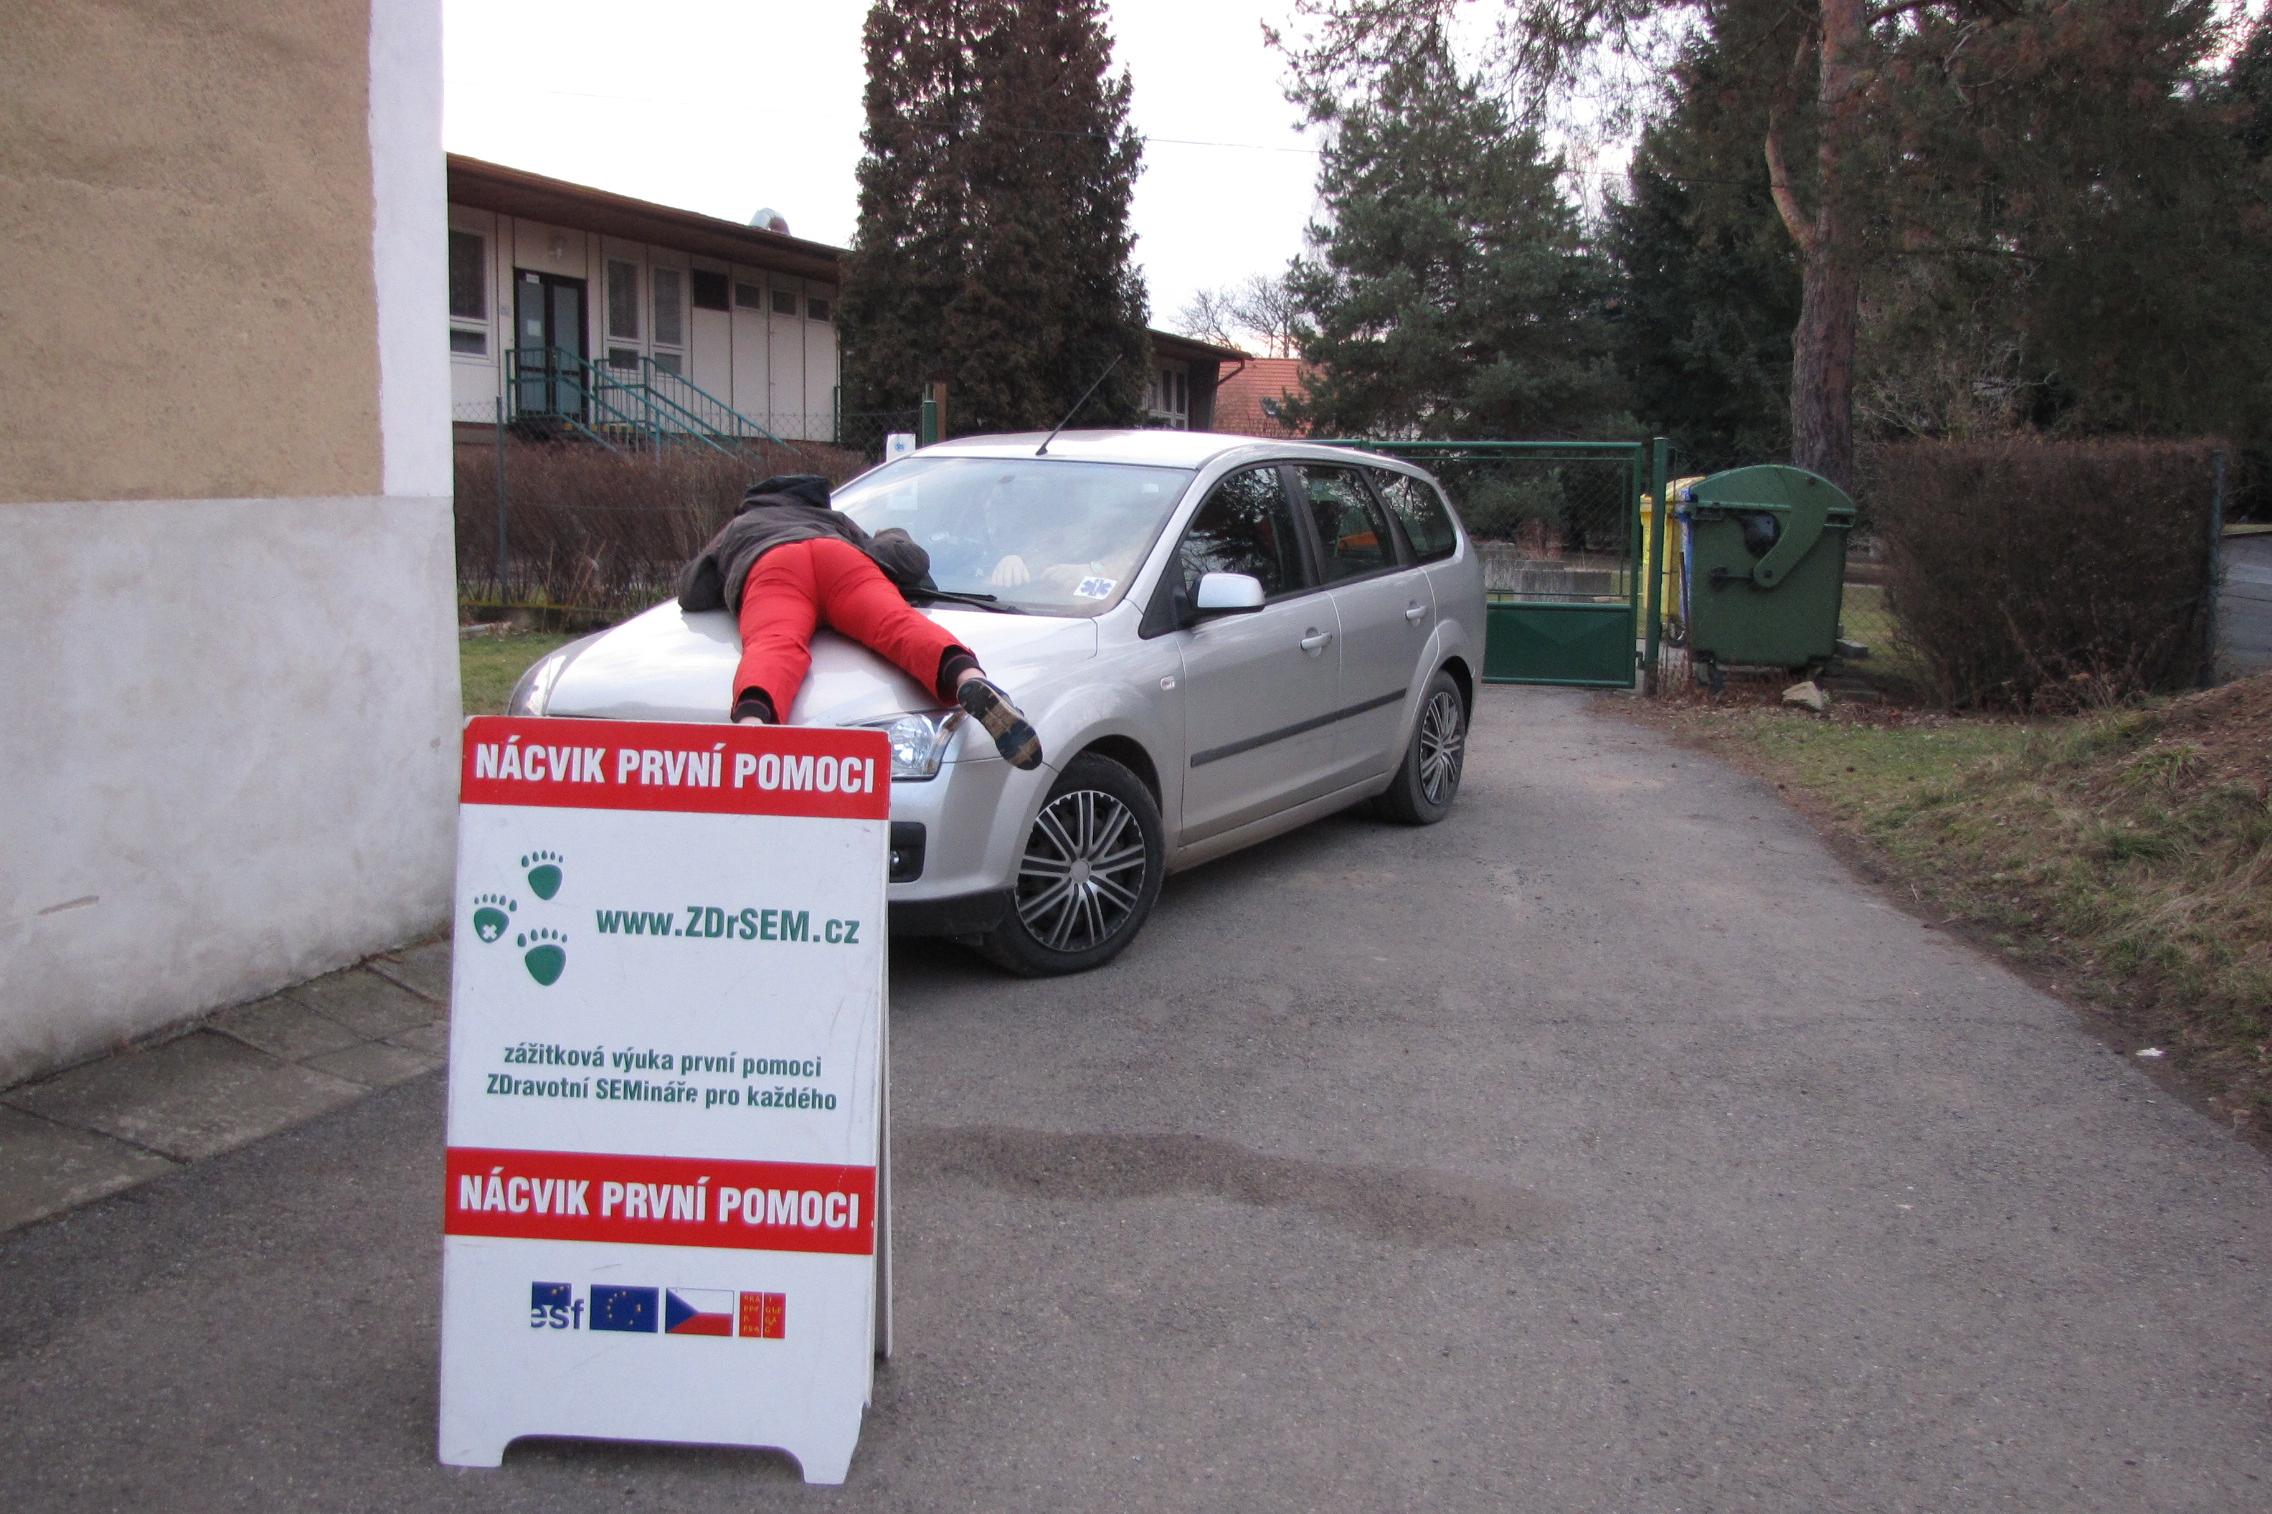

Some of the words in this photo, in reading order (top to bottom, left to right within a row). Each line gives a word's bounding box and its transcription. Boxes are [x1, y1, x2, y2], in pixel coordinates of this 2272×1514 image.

[476, 735, 606, 784] NÁCVIK
[617, 742, 727, 788] PRVNÍ
[733, 753, 875, 794] POMOCI
[596, 905, 860, 945] www.ZDrSEM.cz
[504, 1042, 605, 1067] zážitková
[612, 1046, 674, 1074] výuka
[680, 1051, 736, 1076] první
[742, 1056, 822, 1079] pomoci
[486, 1073, 590, 1099] ZDravotní
[595, 1078, 698, 1103] SEMináře
[705, 1088, 740, 1110] pro
[747, 1085, 837, 1111] každého
[459, 1166, 590, 1216] NÁCVIK
[601, 1175, 711, 1222] PRVNÍ
[718, 1186, 859, 1229] POMOCI
[530, 1298, 585, 1330] esf
